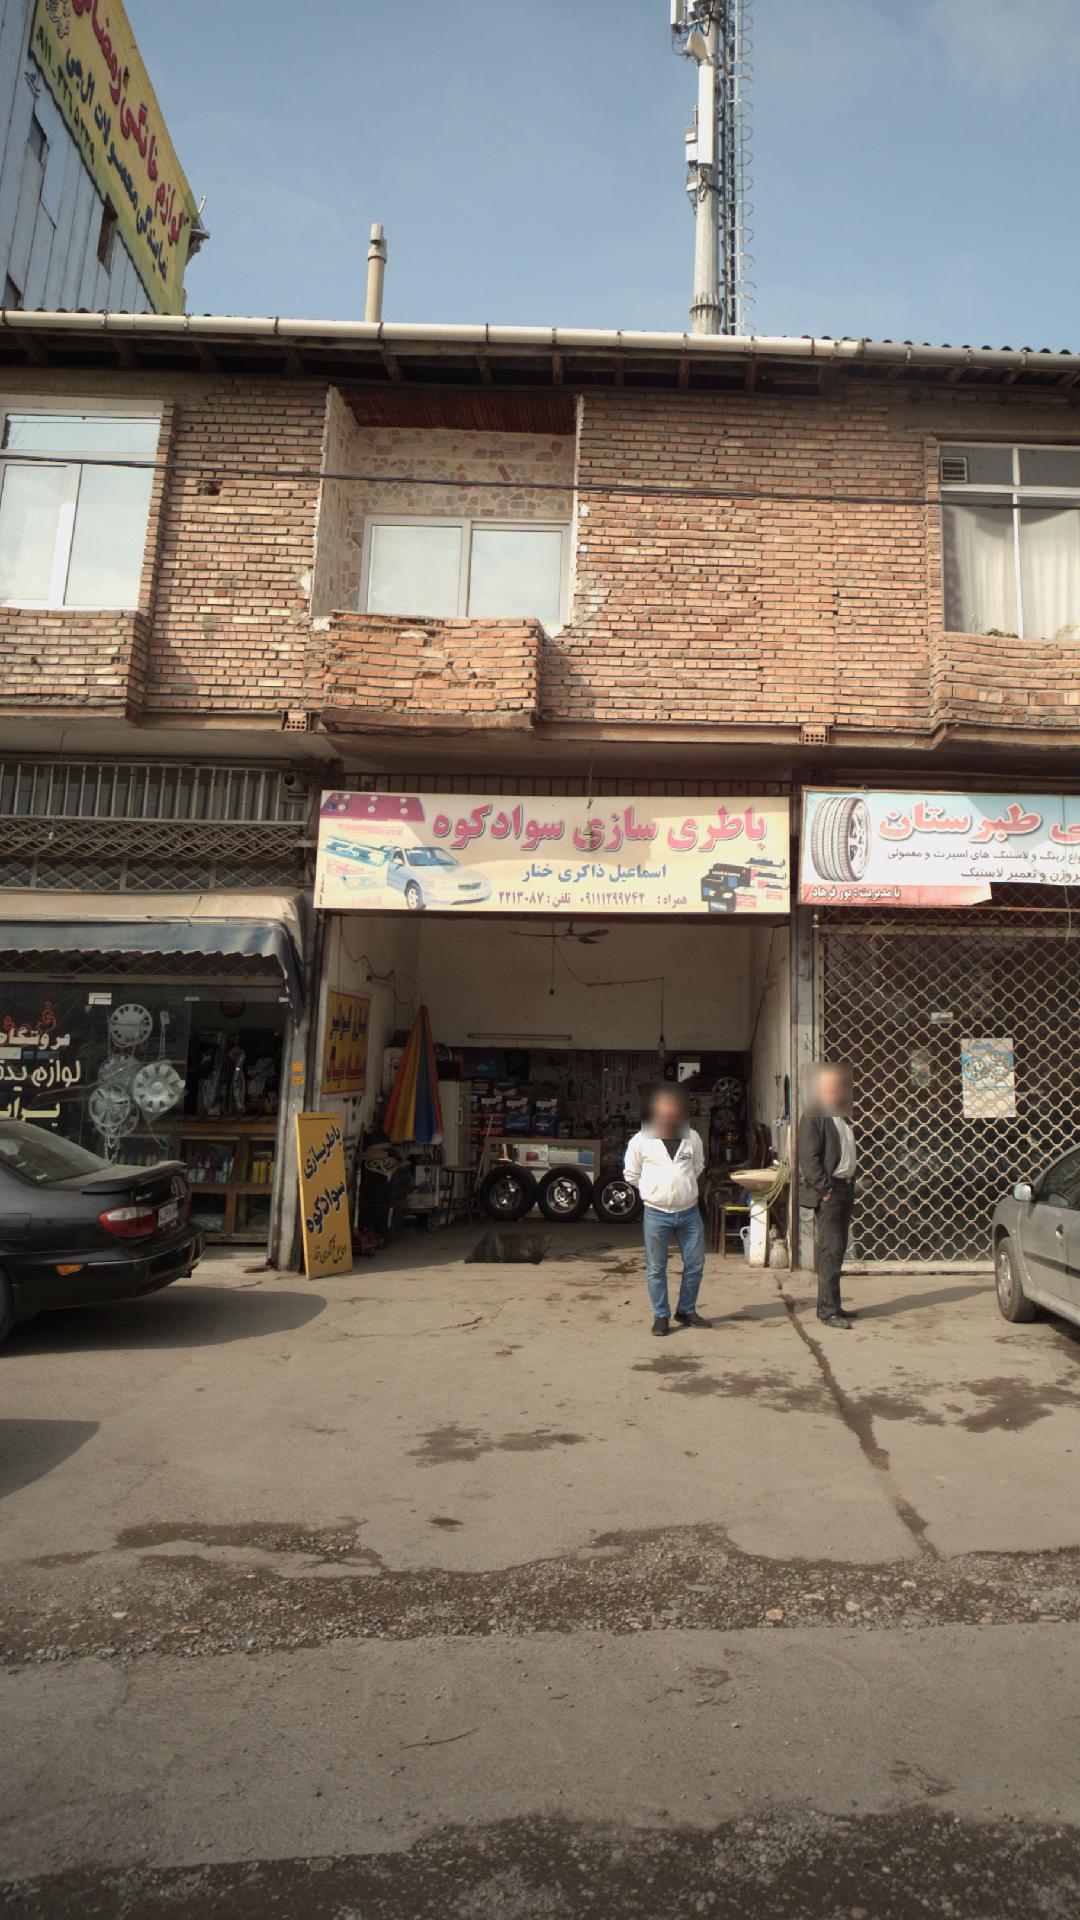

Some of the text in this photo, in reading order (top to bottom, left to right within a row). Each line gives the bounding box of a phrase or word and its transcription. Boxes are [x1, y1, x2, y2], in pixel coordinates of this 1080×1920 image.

[432, 800, 768, 852] باطری سازی سوادکوه
[878, 799, 1043, 845] طبرستان
[887, 848, 922, 861] معمولی
[933, 849, 968, 862] اسپرت
[971, 850, 990, 862] های
[557, 862, 605, 883] ذاکری
[608, 863, 667, 883] اسماعیل
[1006, 868, 1037, 882] تعمیر
[31, 1058, 82, 1088] لوازم
